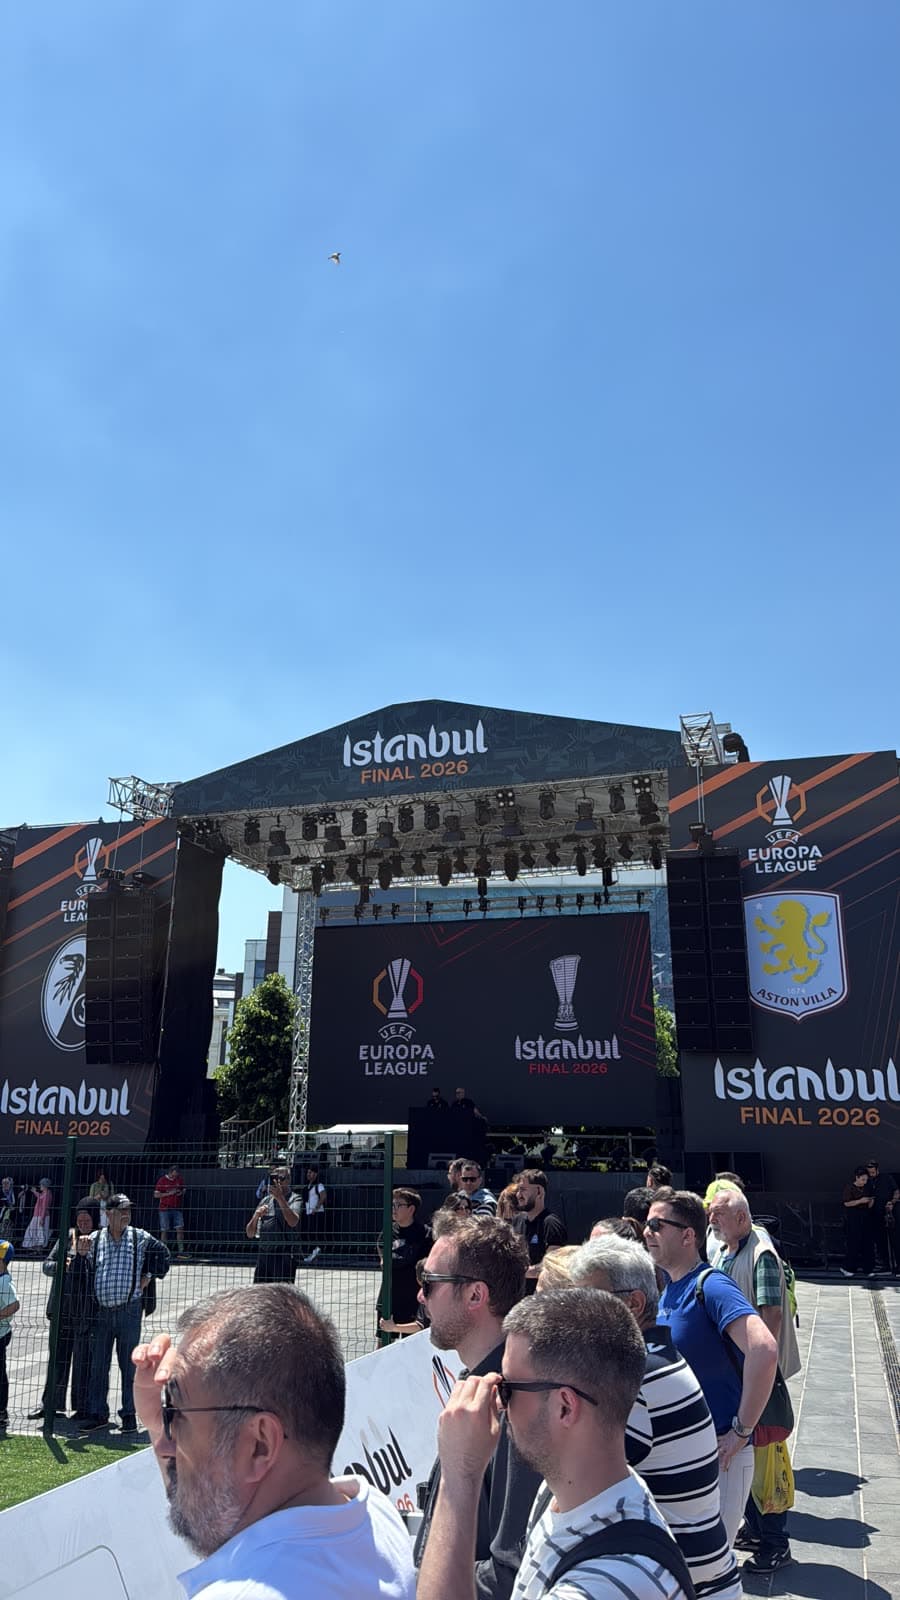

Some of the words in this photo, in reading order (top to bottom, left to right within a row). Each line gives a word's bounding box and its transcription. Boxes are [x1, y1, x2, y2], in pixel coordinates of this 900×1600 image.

[343, 719, 488, 767] Istanbul
[360, 766, 415, 784] FINAL
[420, 760, 469, 778] 2026
[767, 831, 799, 843] UEFA
[748, 845, 823, 861] EUROPA
[755, 860, 817, 874] LEAGUE
[60, 901, 87, 911] EUR
[63, 912, 87, 923] LEA
[757, 989, 799, 1007] ASTON
[801, 987, 837, 1005] VILLA
[380, 1025, 413, 1039] UEFA
[359, 1044, 435, 1060] EUROPA
[515, 1033, 621, 1060] Istanbul
[365, 1061, 428, 1075] LEAGUE
[528, 1062, 569, 1074] FINAL
[572, 1062, 608, 1074] 2026
[713, 1057, 900, 1101] Istanbul
[0, 1079, 130, 1116] Istanbul
[740, 1106, 812, 1125] FINAL
[818, 1107, 881, 1126] 2026
[15, 1120, 63, 1136] FINAL
[68, 1120, 111, 1136] 2026
